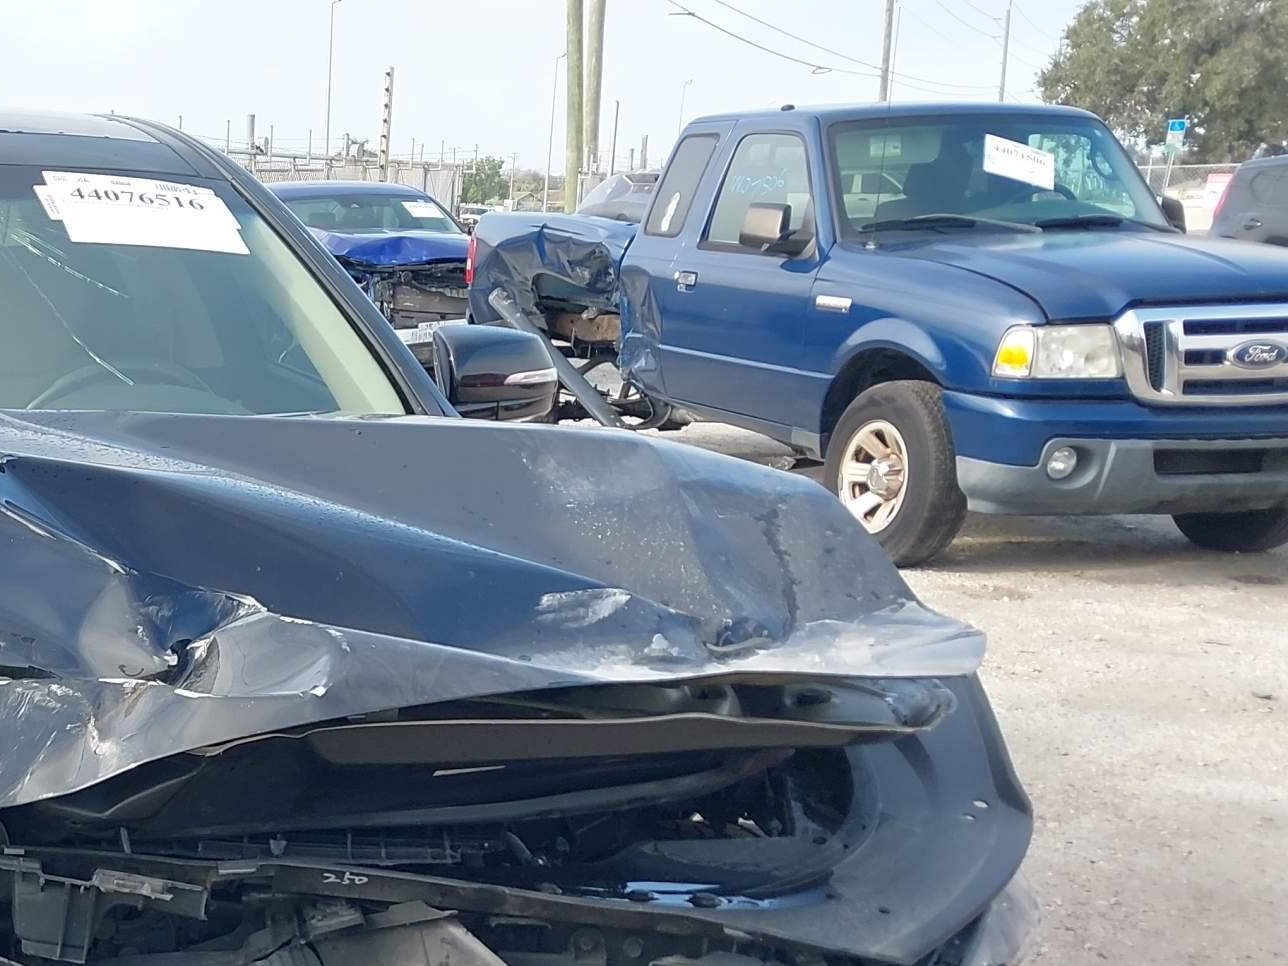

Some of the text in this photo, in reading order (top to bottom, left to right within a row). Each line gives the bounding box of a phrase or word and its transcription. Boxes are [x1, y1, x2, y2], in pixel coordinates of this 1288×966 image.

[70, 187, 205, 211] 44076516
[1244, 345, 1279, 362] Ford
[322, 871, 369, 885] 250
